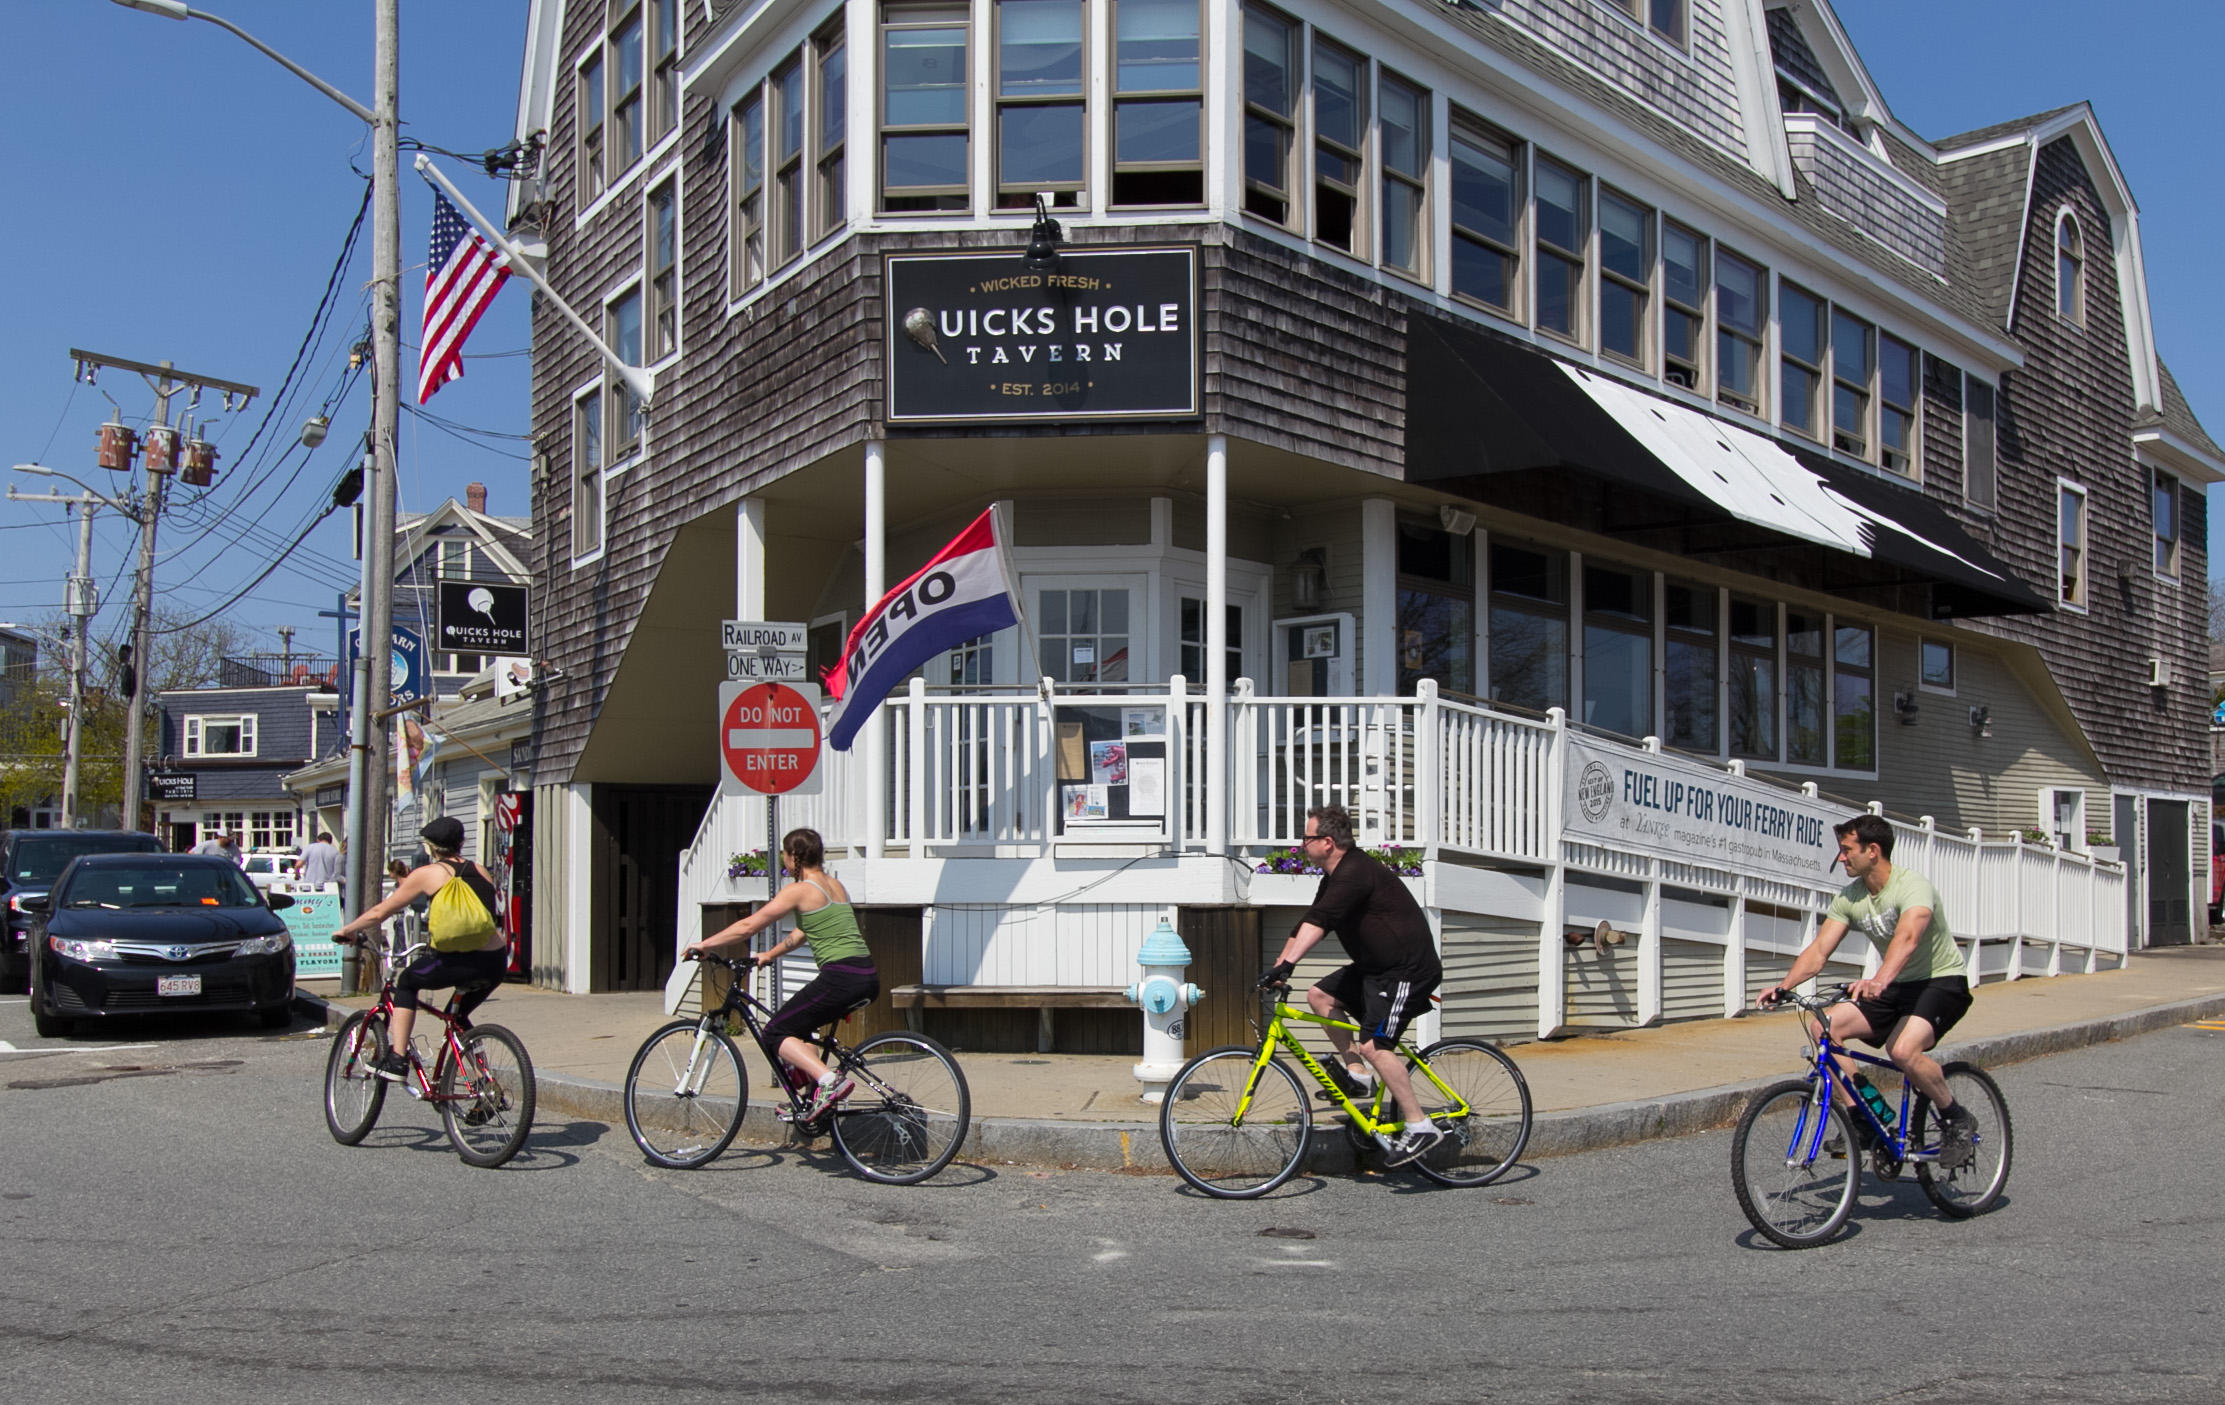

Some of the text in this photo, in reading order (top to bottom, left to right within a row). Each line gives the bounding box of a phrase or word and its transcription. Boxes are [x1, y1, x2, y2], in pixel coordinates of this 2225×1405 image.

[981, 275, 1100, 293] WICKED FRESH
[1074, 303, 1179, 334] HOLE
[966, 343, 1123, 364] TAVERN
[1002, 382, 1080, 396] EST. 2014
[462, 636, 508, 645] TAVERN
[493, 629, 522, 639] HOLE
[724, 624, 802, 646] RAILROAD AV
[729, 655, 791, 677] ONE WAY
[740, 706, 802, 724] DO NOT
[746, 754, 799, 771] ENTER
[1624, 769, 1824, 848] FUEL UP FOR YOUR FERRY RIDE
[1620, 817, 1629, 830] at
[1674, 829, 1717, 849] magazine's
[1728, 840, 1763, 858] gastropub
[1764, 849, 1771, 860] in
